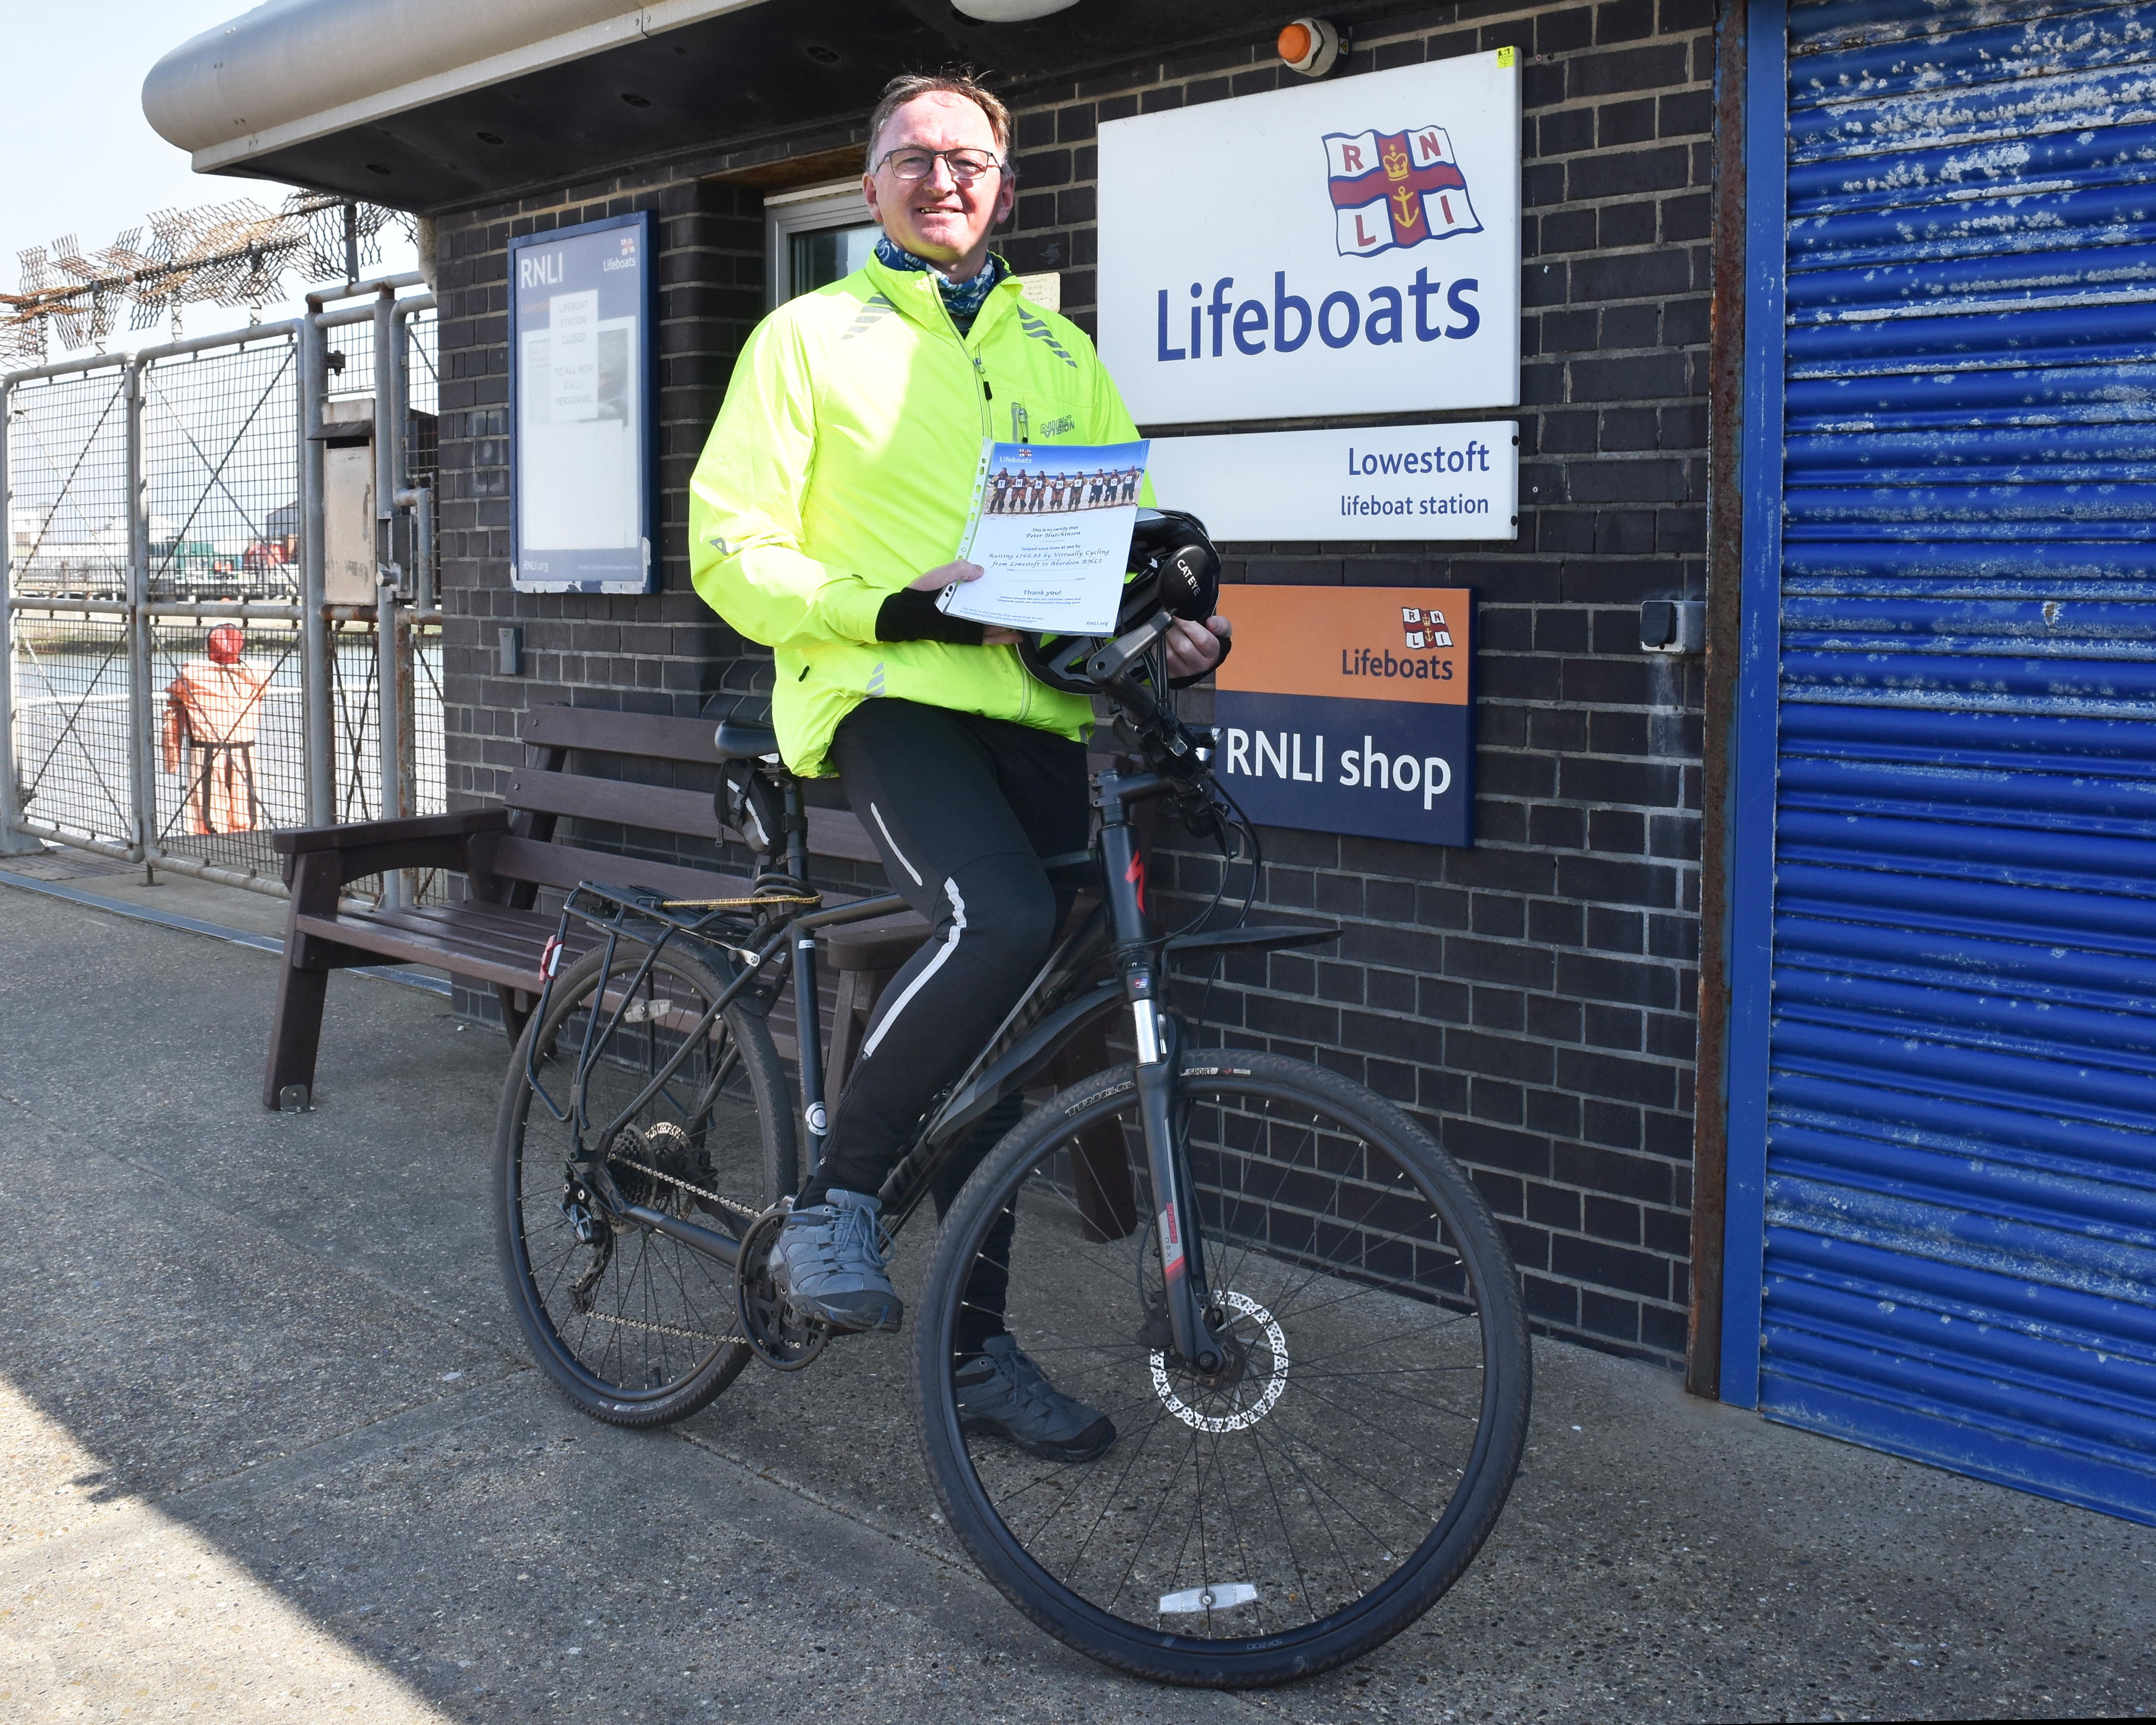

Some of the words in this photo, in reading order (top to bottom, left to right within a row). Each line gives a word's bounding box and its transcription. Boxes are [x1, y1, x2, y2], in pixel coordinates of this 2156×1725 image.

[1342, 144, 1364, 172] R
[1422, 132, 1442, 160] N
[1355, 215, 1376, 247] L
[1441, 195, 1455, 225] I
[521, 253, 563, 289] RNLI
[604, 257, 636, 271] Lifeboats
[559, 300, 588, 313] LIFEBOAT
[560, 315, 587, 327] STATION
[1157, 266, 1481, 362] Lifeboats
[561, 332, 586, 344] CLOSED
[555, 367, 563, 376] TO
[565, 367, 577, 375] ALL
[578, 364, 593, 373] NON
[556, 394, 592, 406] PERSONNEL
[1349, 440, 1490, 475] Lowestoft
[1341, 495, 1413, 516] lifeboat
[1419, 493, 1488, 515] station
[1043, 552, 1051, 560] by
[1054, 550, 1083, 558] Virtually
[1086, 548, 1109, 557] Cycling
[523, 560, 549, 573] RNLI.org
[1009, 560, 1040, 568] Lowestoft
[1177, 559, 1201, 596] CATEYE
[1408, 611, 1416, 621] R
[1433, 612, 1442, 621] N
[1412, 634, 1419, 645] L
[1342, 648, 1453, 680] Lifeboats
[1227, 728, 1323, 782] RNLI
[1339, 735, 1451, 810] shop
[1189, 1068, 1213, 1076] SPORT
[1064, 1081, 1136, 1117] TRIGG
[1168, 1214, 1178, 1244] SUNTOUR
